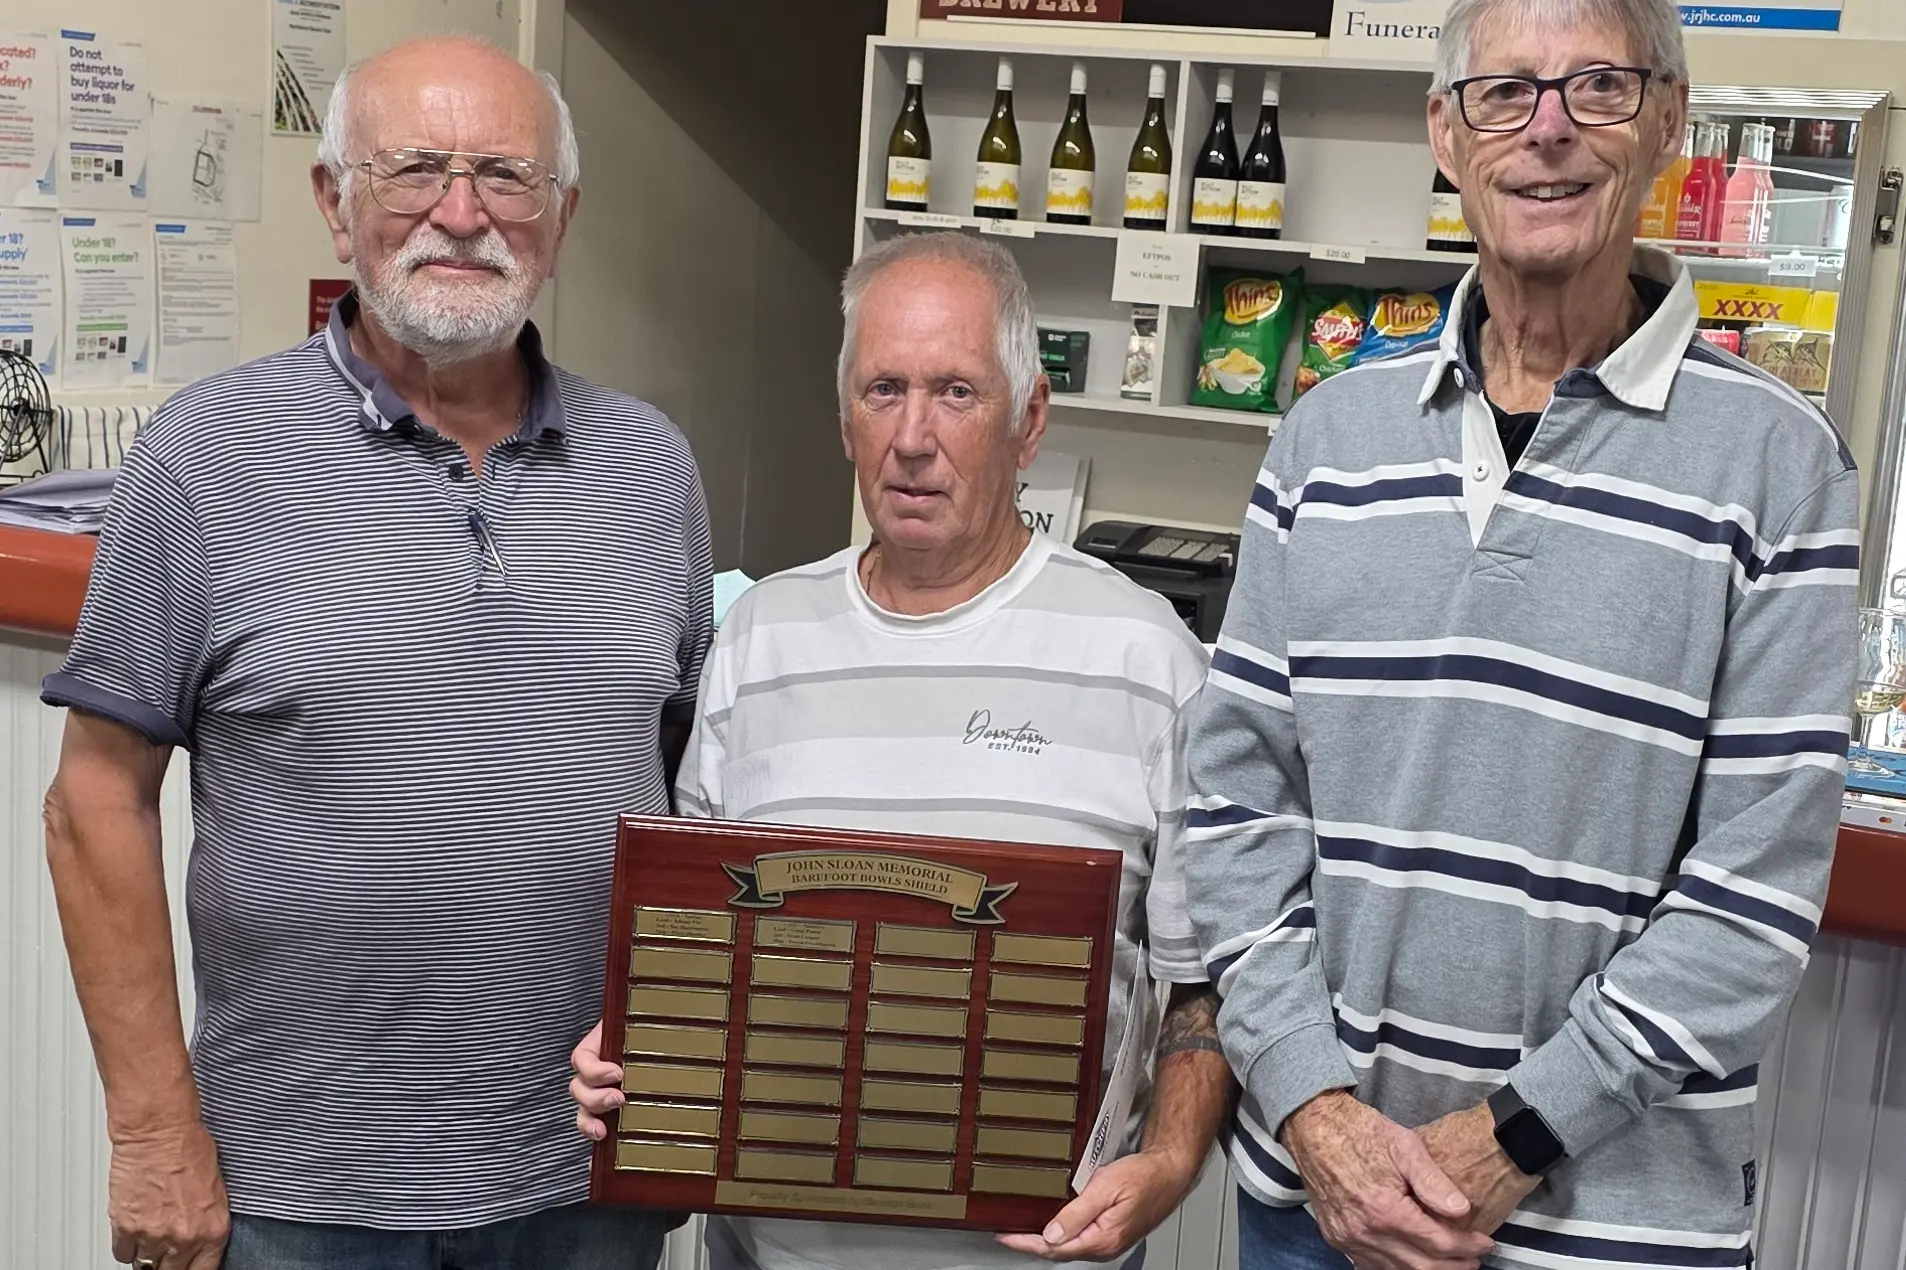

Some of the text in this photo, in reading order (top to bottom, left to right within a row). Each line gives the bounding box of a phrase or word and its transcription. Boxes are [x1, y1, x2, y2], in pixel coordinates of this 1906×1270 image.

[69, 46, 102, 60] Do not
[70, 62, 123, 77] attempt to
[70, 74, 135, 91] buy liquor for
[71, 90, 100, 103] under
[72, 235, 101, 248] Under
[73, 251, 139, 264] Can you enter?
[1326, 249, 1351, 260] $20.00
[1780, 263, 1806, 271] $9.00
[1227, 283, 1279, 315] Thins
[1380, 296, 1433, 328] Thins
[1712, 299, 1784, 320] XXXX
[988, 742, 1012, 751] EST.
[786, 859, 954, 884] JOHN SLOAN MEMORIAL
[791, 873, 948, 894] BAREFOOT BOWLS SHIELD
